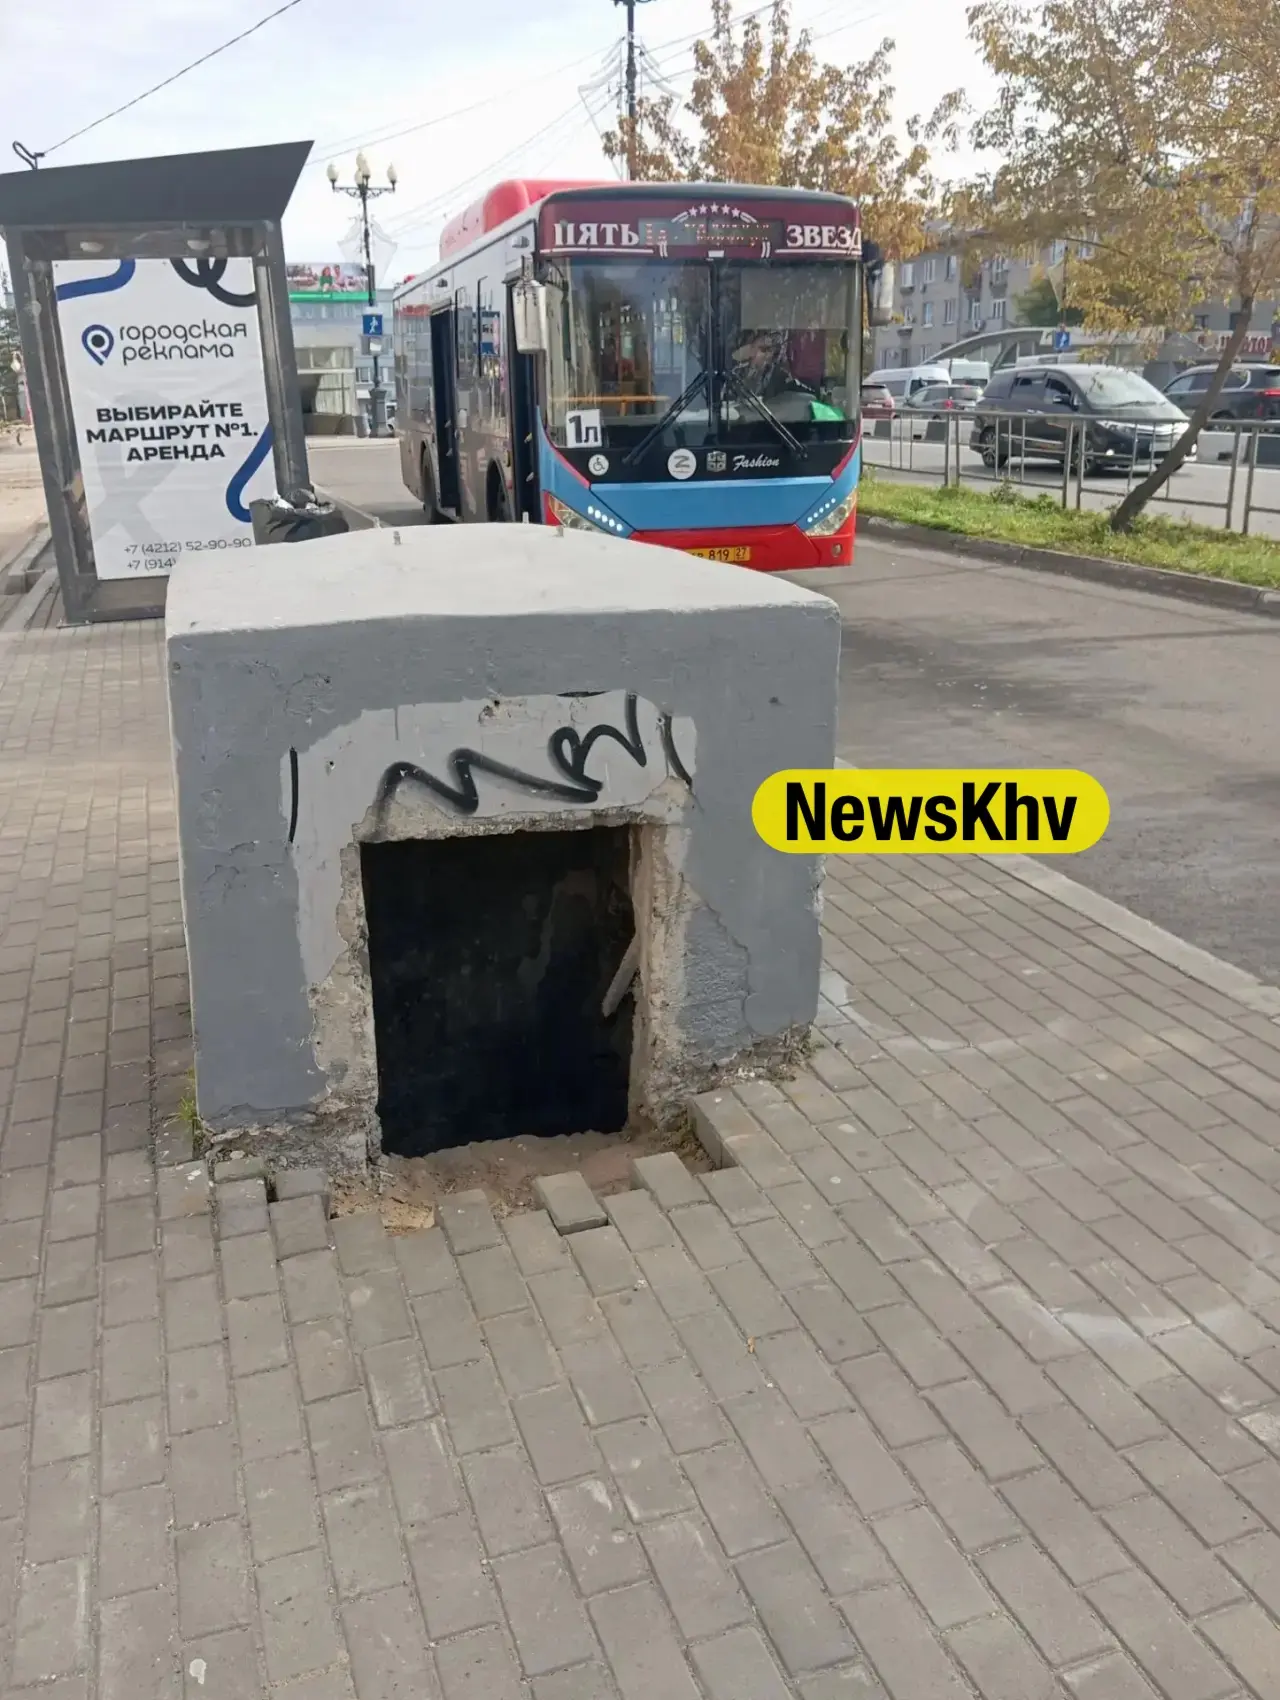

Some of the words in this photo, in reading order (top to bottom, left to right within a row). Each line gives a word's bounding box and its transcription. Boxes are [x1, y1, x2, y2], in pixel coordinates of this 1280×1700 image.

[554, 223, 640, 246] ПЯТЬ
[119, 319, 248, 345] городская
[122, 340, 234, 366] реклама
[96, 399, 243, 423] ВЫБИРАЙТЕ
[86, 424, 209, 443] МАРШРУТ
[127, 443, 225, 461] АРЕНДА
[732, 454, 780, 471] Fashion
[124, 544, 138, 555] +7
[141, 541, 182, 555] (4212)
[185, 537, 252, 551] 52-90-90
[708, 549, 730, 561] 819
[735, 547, 747, 557] 27
[127, 560, 141, 571] +7
